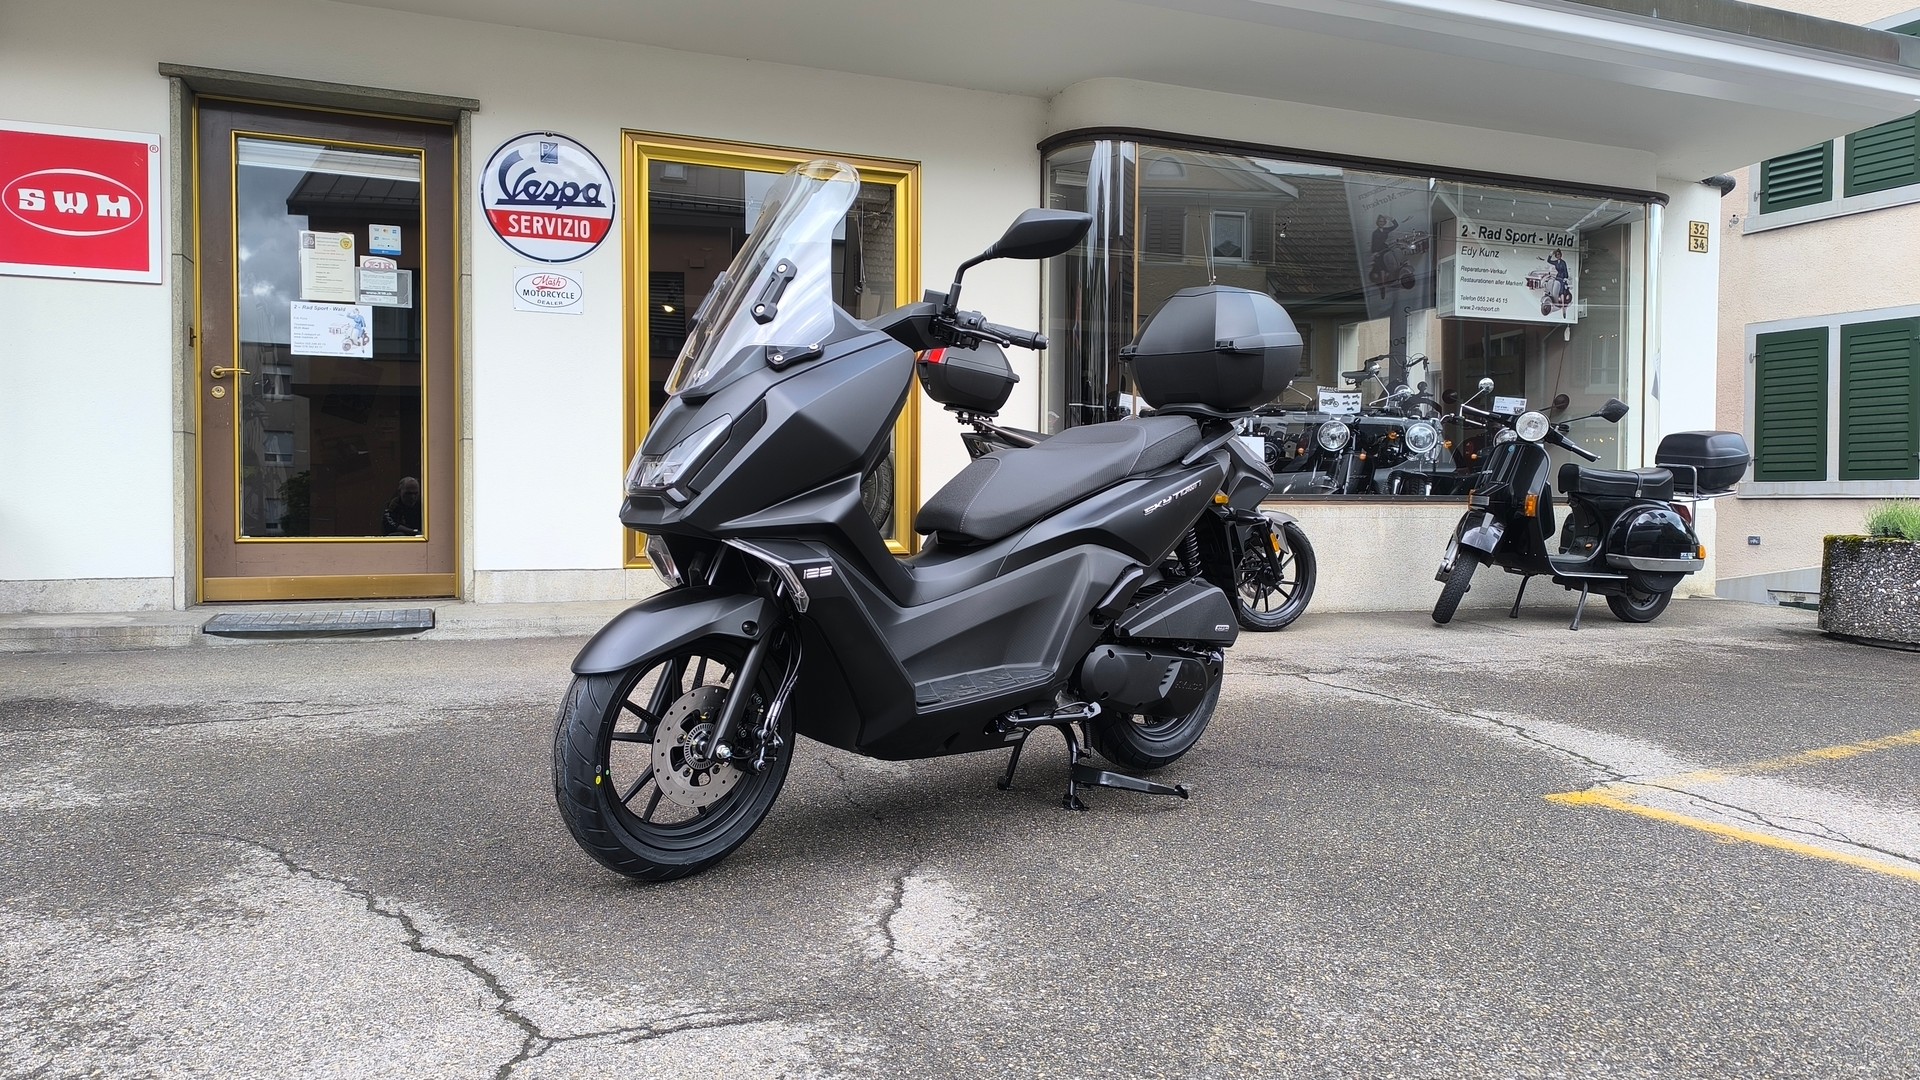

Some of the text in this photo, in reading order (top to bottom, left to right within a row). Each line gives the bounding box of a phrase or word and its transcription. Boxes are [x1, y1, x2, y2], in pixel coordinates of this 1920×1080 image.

[495, 149, 607, 210] Vespa
[18, 188, 131, 219] SWM
[508, 214, 591, 239] SERVIZIO
[1693, 223, 1705, 235] 32
[1461, 224, 1469, 237] 2
[1478, 226, 1502, 240] Rad
[1505, 228, 1537, 244] Sport
[1546, 232, 1575, 247] Wald
[1461, 245, 1500, 258] Edy Kunz
[1693, 238, 1705, 250] 34
[532, 274, 567, 289] Mash
[1460, 276, 1494, 284] Restaurationen
[522, 289, 575, 300] MOTORCYCLE
[803, 565, 833, 580] 125
